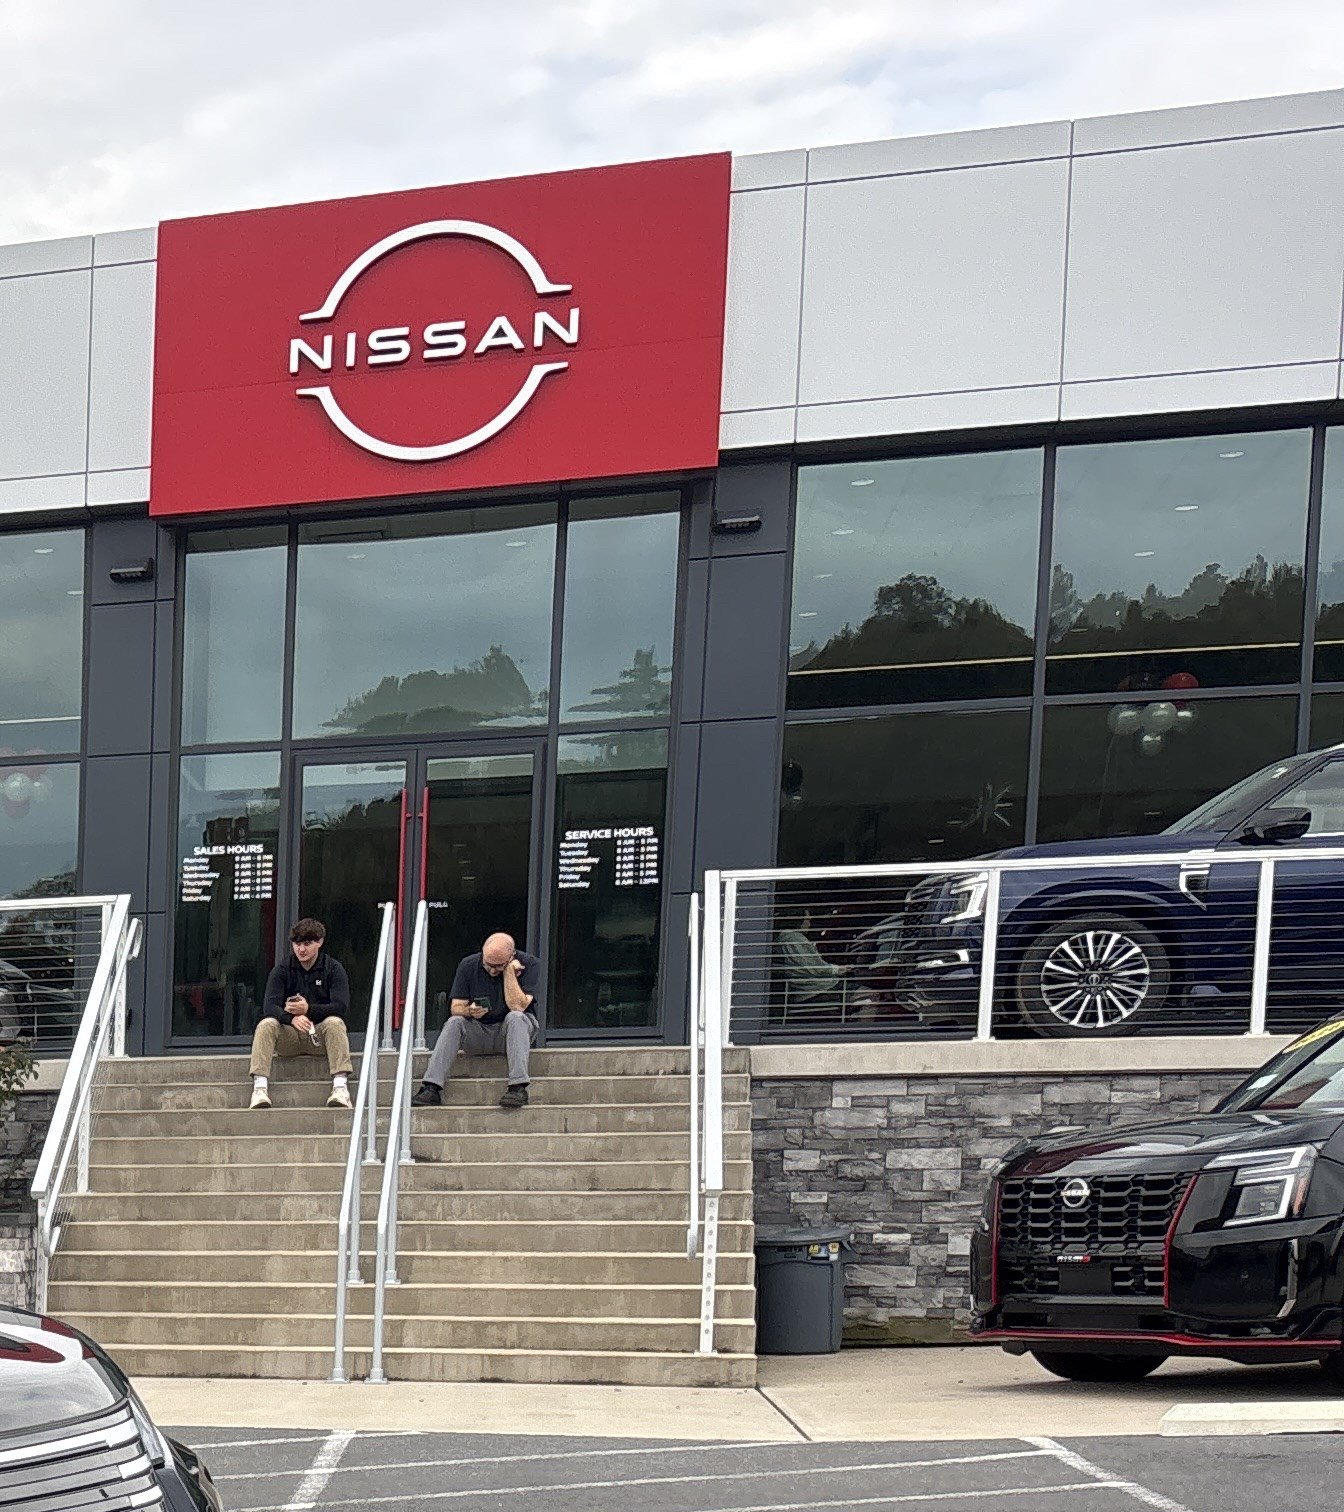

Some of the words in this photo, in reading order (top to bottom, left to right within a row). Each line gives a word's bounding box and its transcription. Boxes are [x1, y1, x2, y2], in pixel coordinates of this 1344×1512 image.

[289, 306, 580, 375] NISSAN
[565, 829, 612, 840] SERVICE
[614, 827, 654, 837] HOURS
[194, 846, 225, 855] SALES
[227, 844, 264, 854] HOURS
